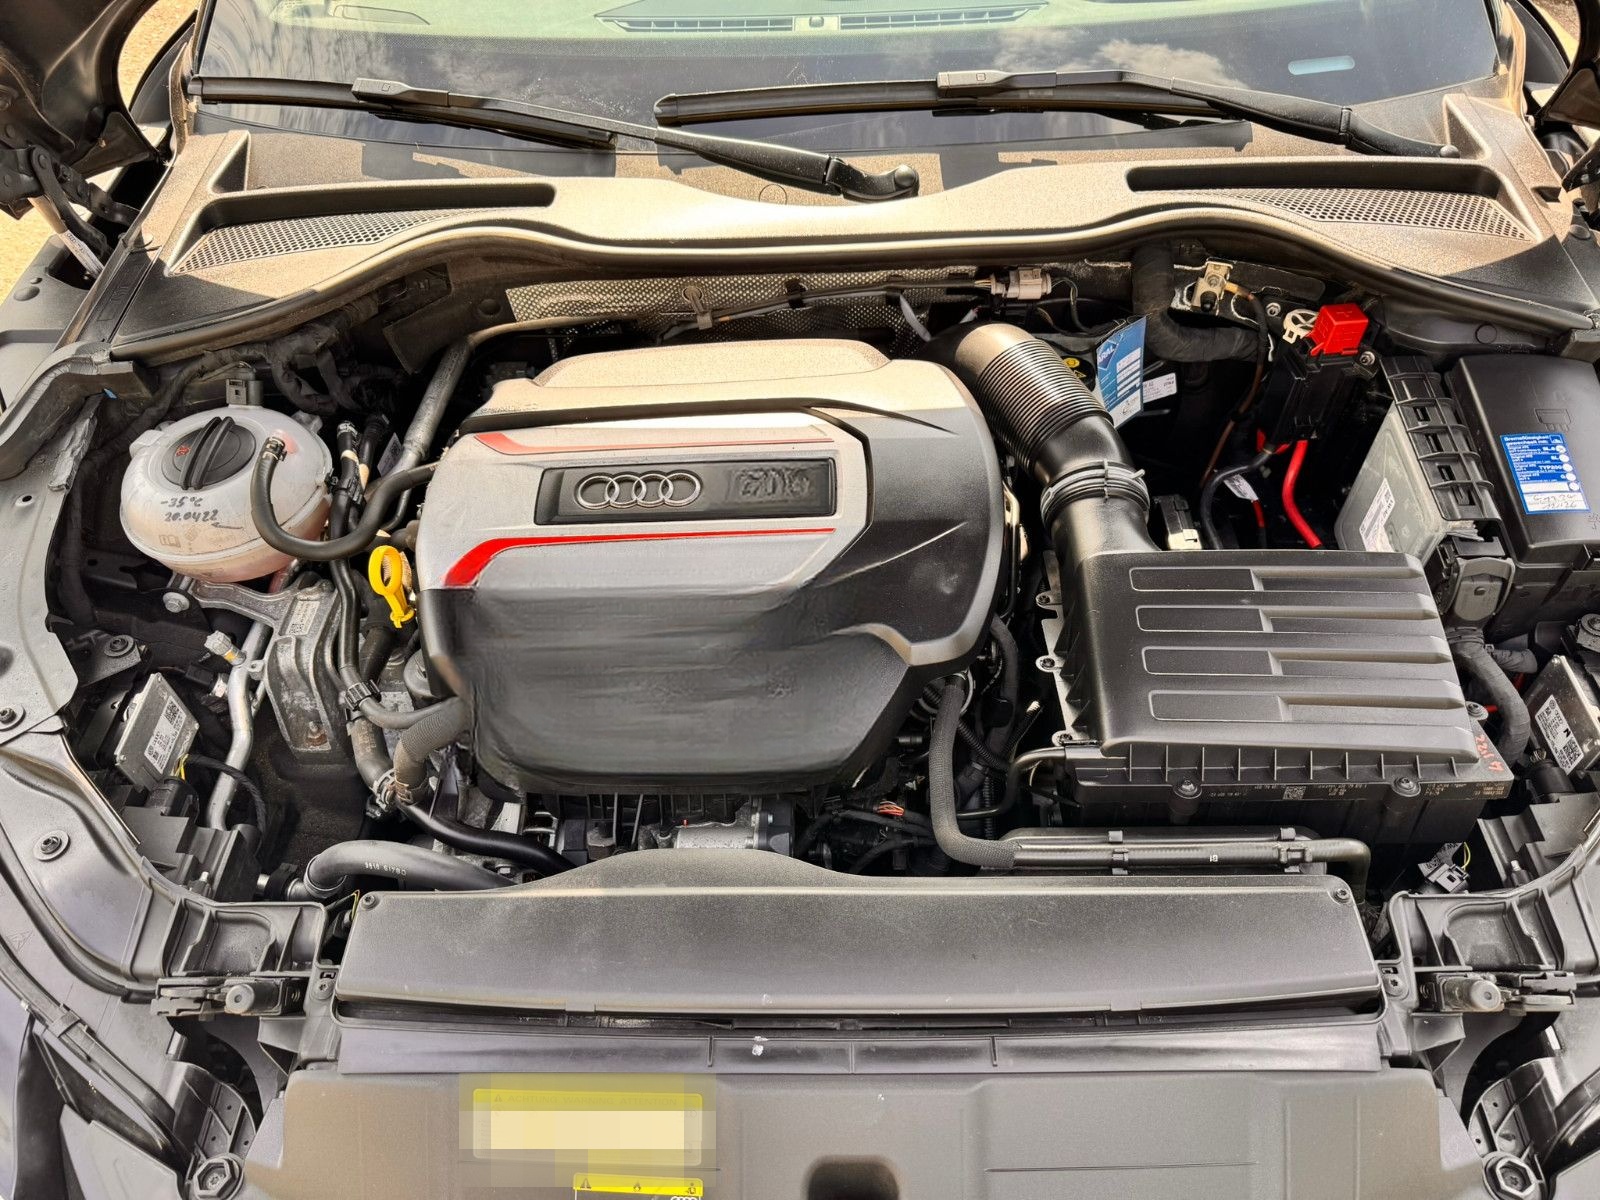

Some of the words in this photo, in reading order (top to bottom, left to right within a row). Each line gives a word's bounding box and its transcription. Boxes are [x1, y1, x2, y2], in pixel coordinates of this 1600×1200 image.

[508, 1095, 558, 1104] ACHTUNG
[562, 1096, 613, 1105] WARNING
[619, 1097, 677, 1106] ATTENTION
